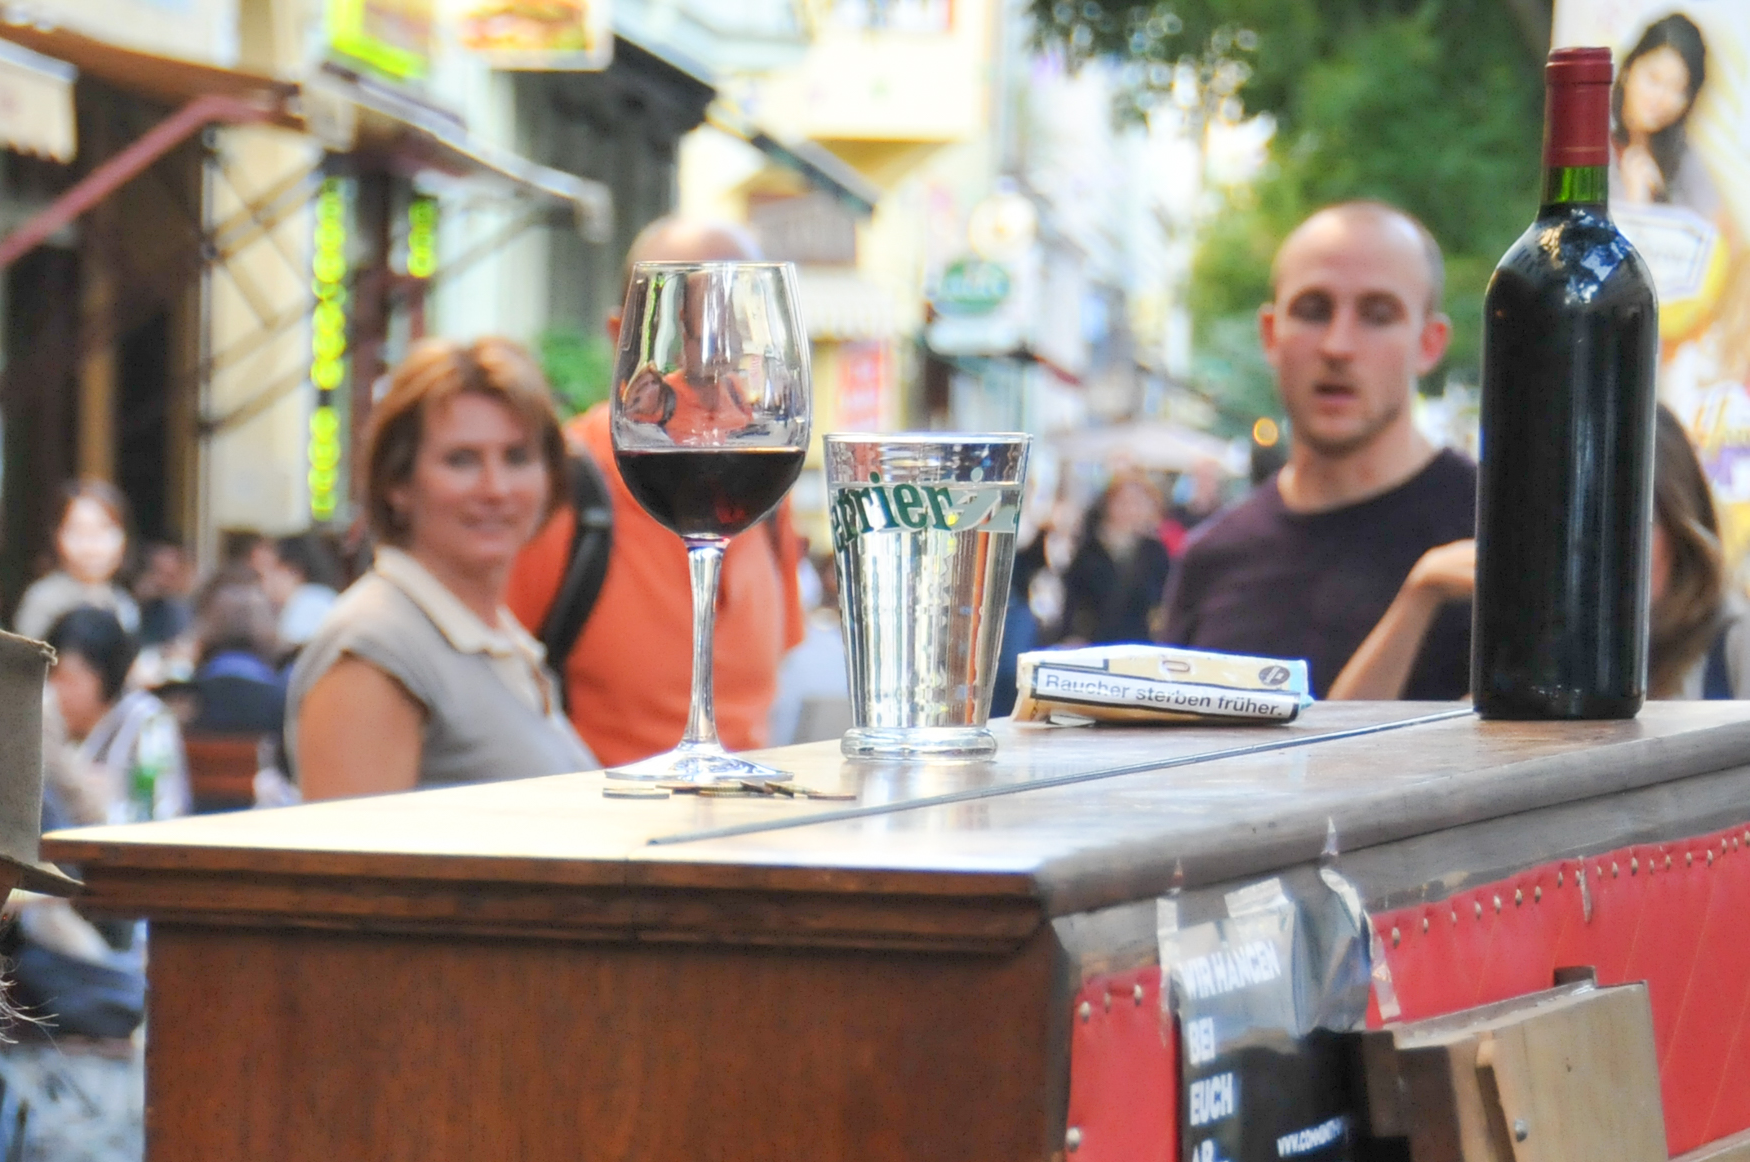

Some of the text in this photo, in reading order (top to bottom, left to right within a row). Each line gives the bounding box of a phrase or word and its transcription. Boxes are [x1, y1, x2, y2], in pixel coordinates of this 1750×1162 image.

[1046, 674, 1283, 717] Raucher sterben früher.
[1189, 1072, 1234, 1127] EUCH
